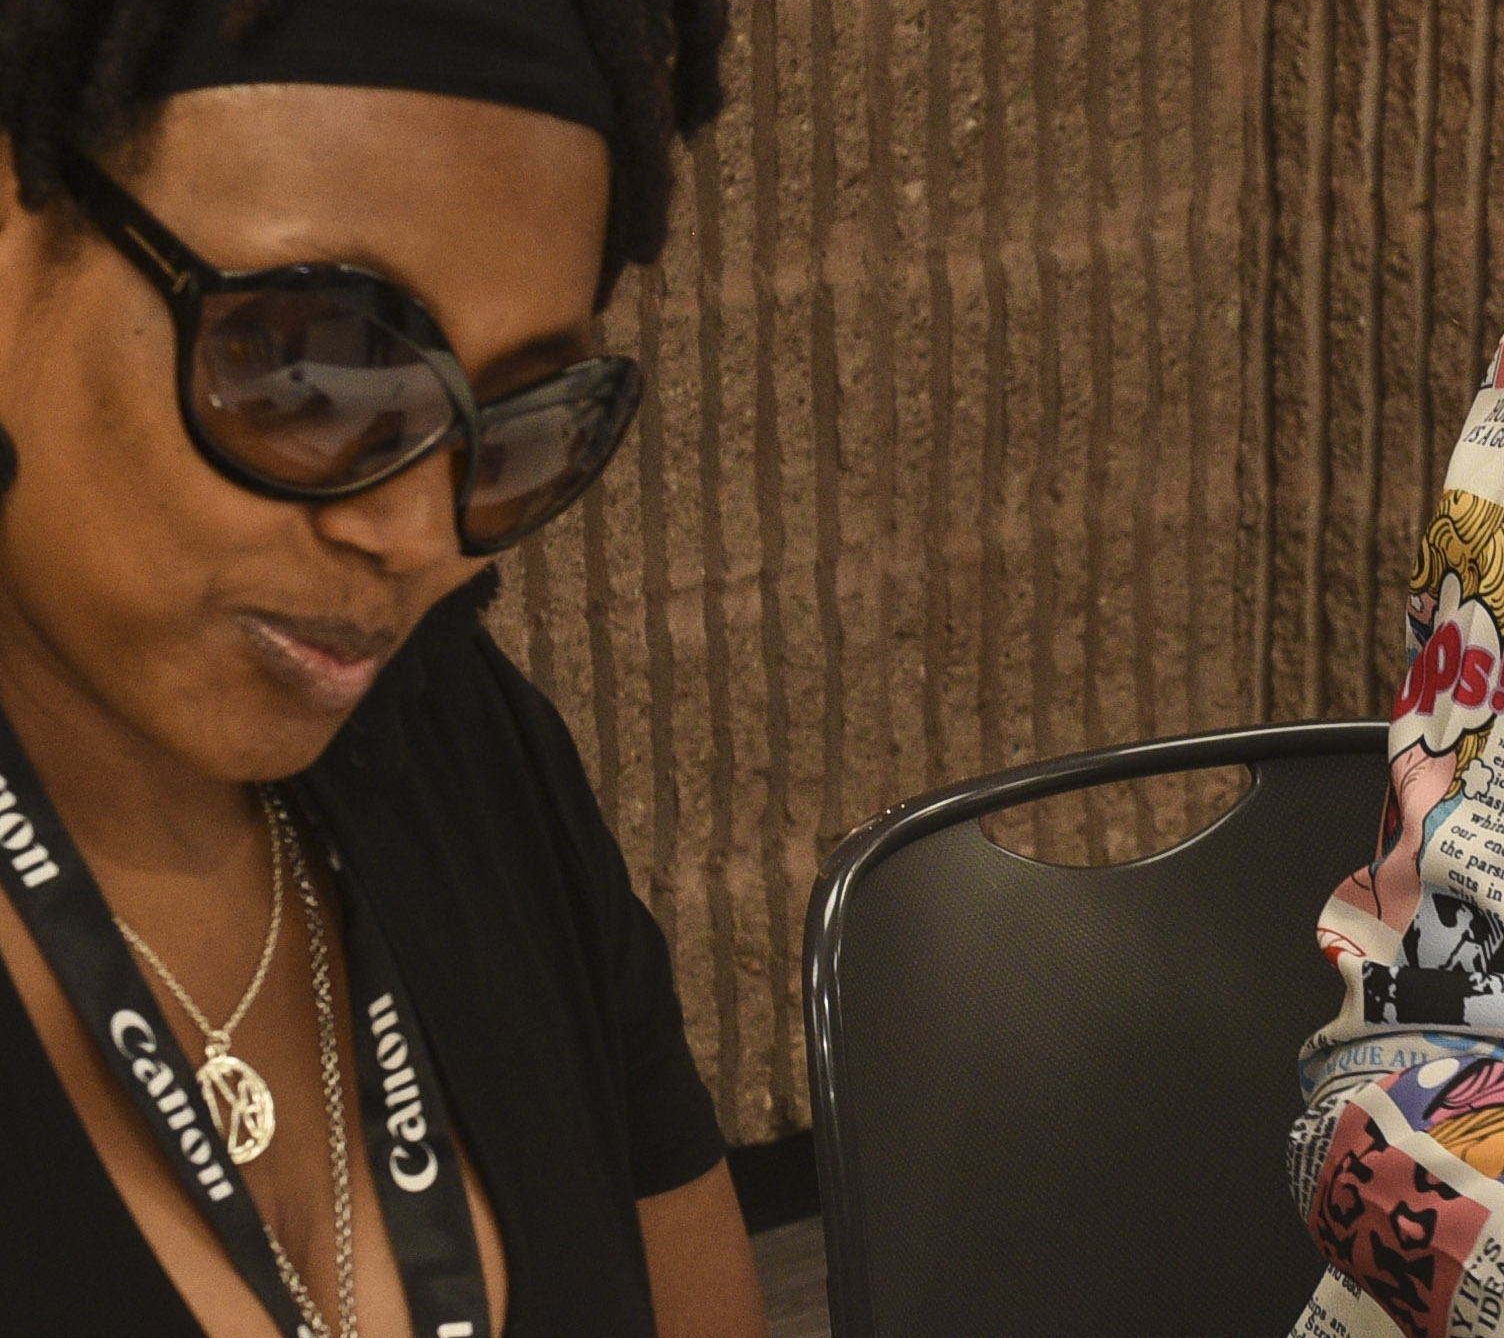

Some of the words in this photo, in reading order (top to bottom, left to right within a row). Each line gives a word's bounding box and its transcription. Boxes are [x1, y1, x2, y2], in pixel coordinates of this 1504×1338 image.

[1439, 839, 1465, 860] the
[1448, 868, 1480, 893] cuts
[1486, 883, 1503, 902] in
[109, 1008, 235, 1202] Canon
[367, 992, 439, 1193] Canon
[1455, 1237, 1503, 1309] IT'S
